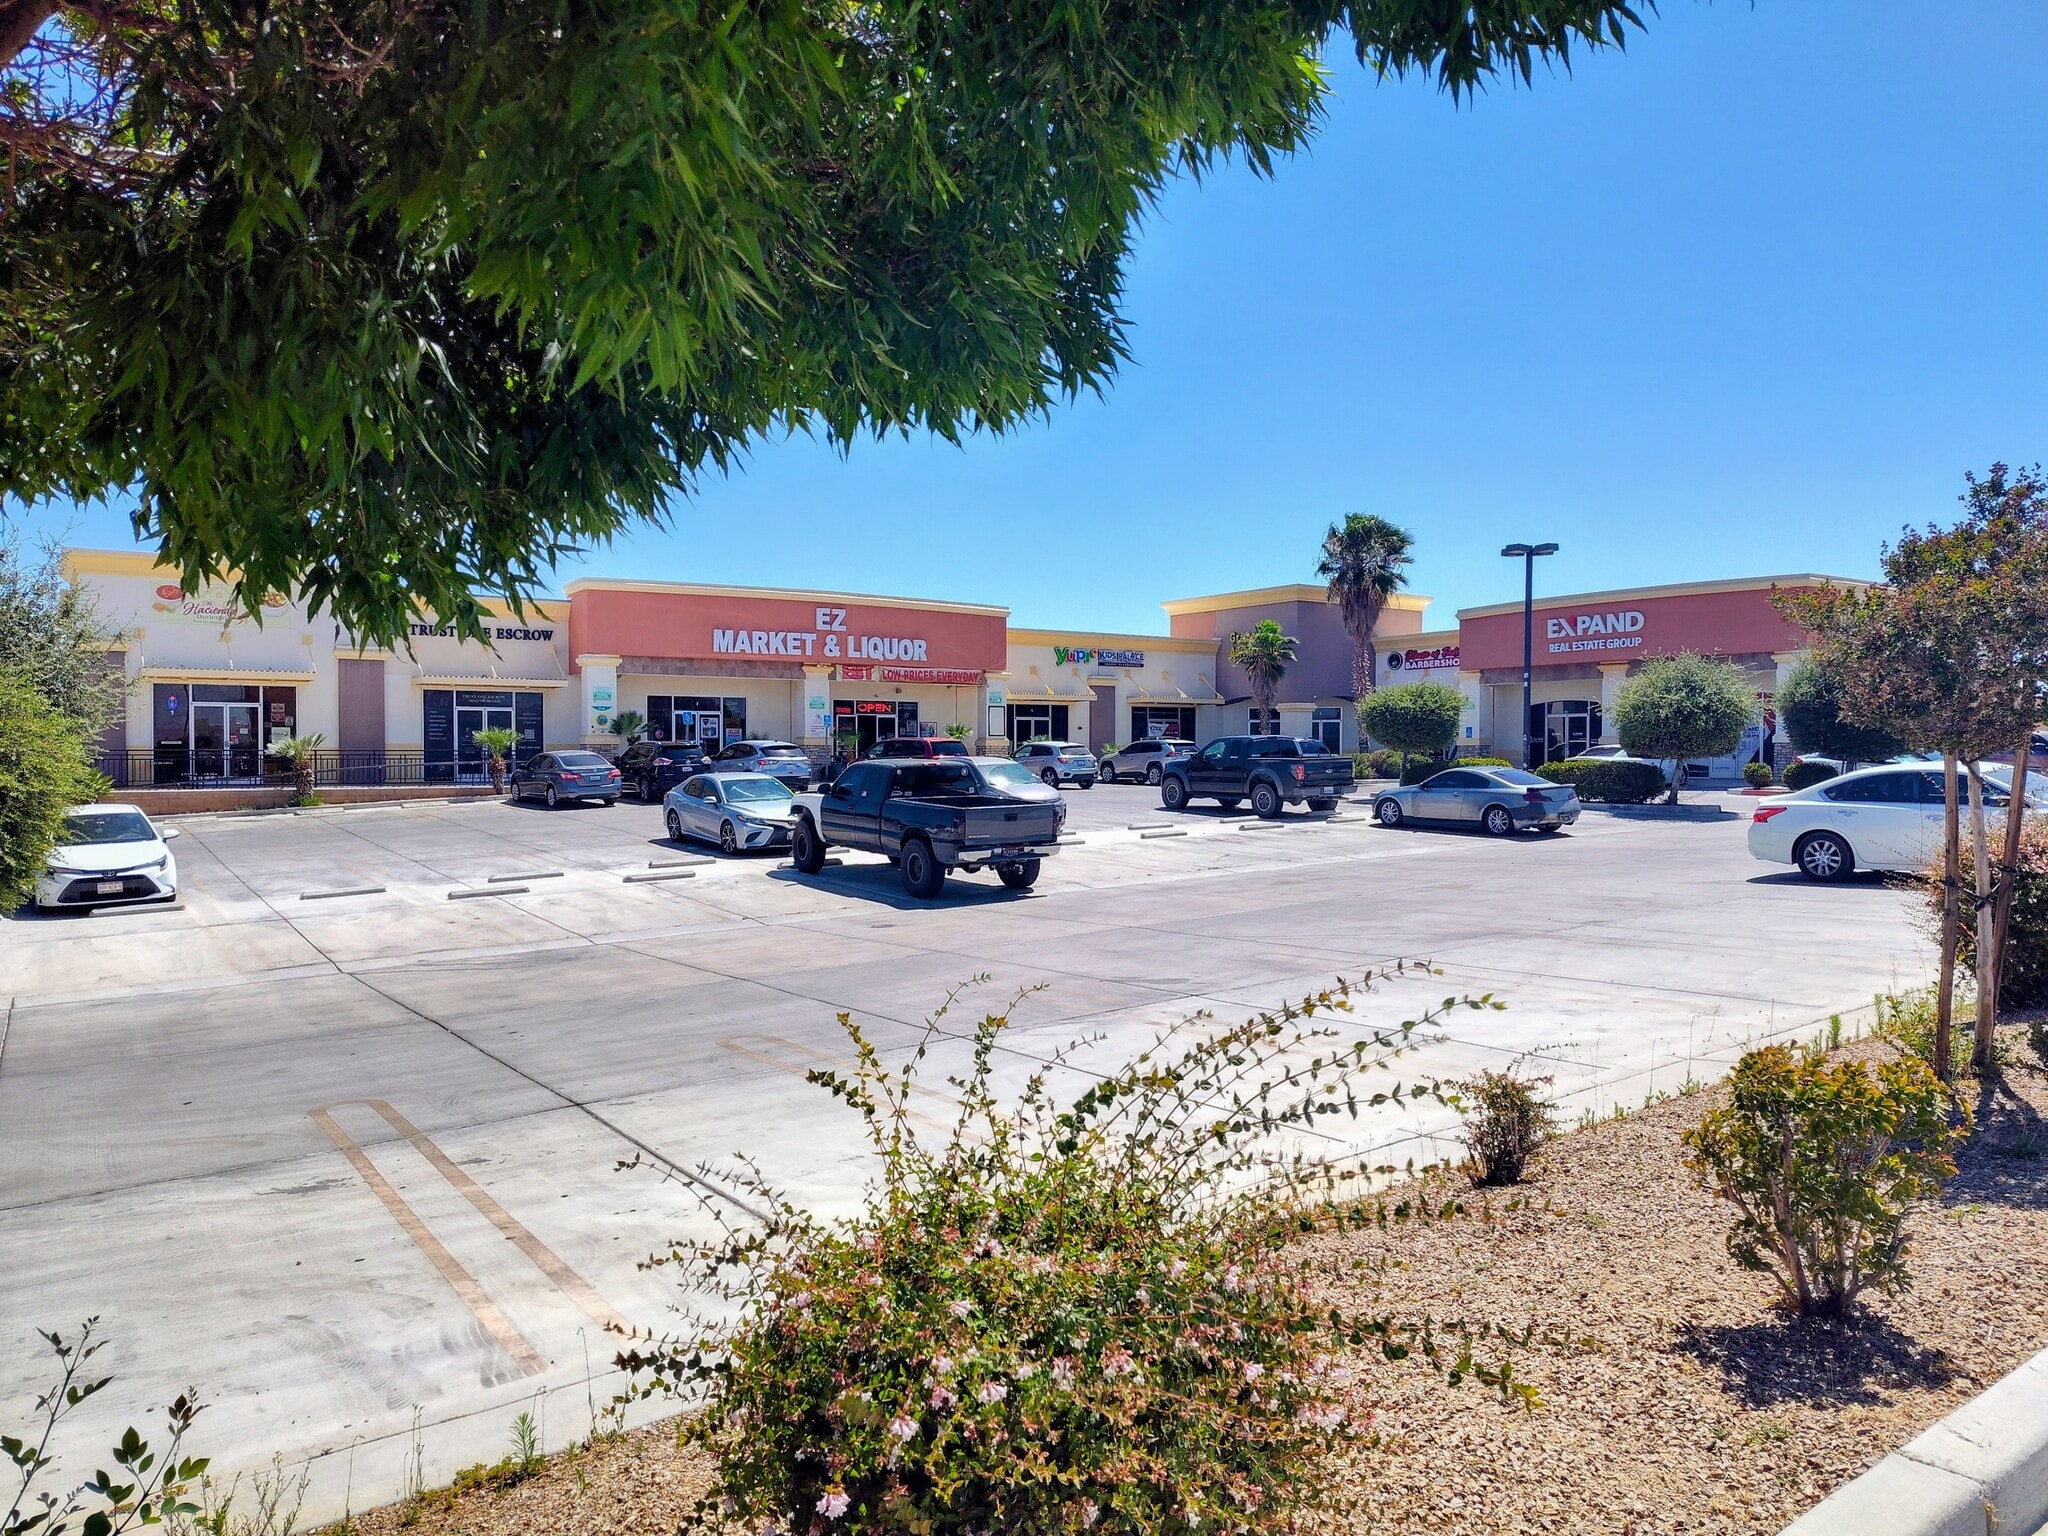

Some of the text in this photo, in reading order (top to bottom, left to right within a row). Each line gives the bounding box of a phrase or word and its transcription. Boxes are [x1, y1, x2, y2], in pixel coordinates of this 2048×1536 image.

[815, 607, 847, 632] EZ
[1547, 611, 1645, 639] EXPAND
[410, 624, 457, 637] TRUST
[496, 628, 554, 642] ESCROW
[713, 628, 928, 662] MARKET & LIQUOR
[1549, 637, 1642, 653] REAL ESTATE GROUP
[1099, 651, 1116, 660] KIDS
[1405, 658, 1460, 670] BARBERSHO
[882, 668, 979, 683] LOW PRICES EVERYDAY
[857, 703, 892, 713] OPEN
